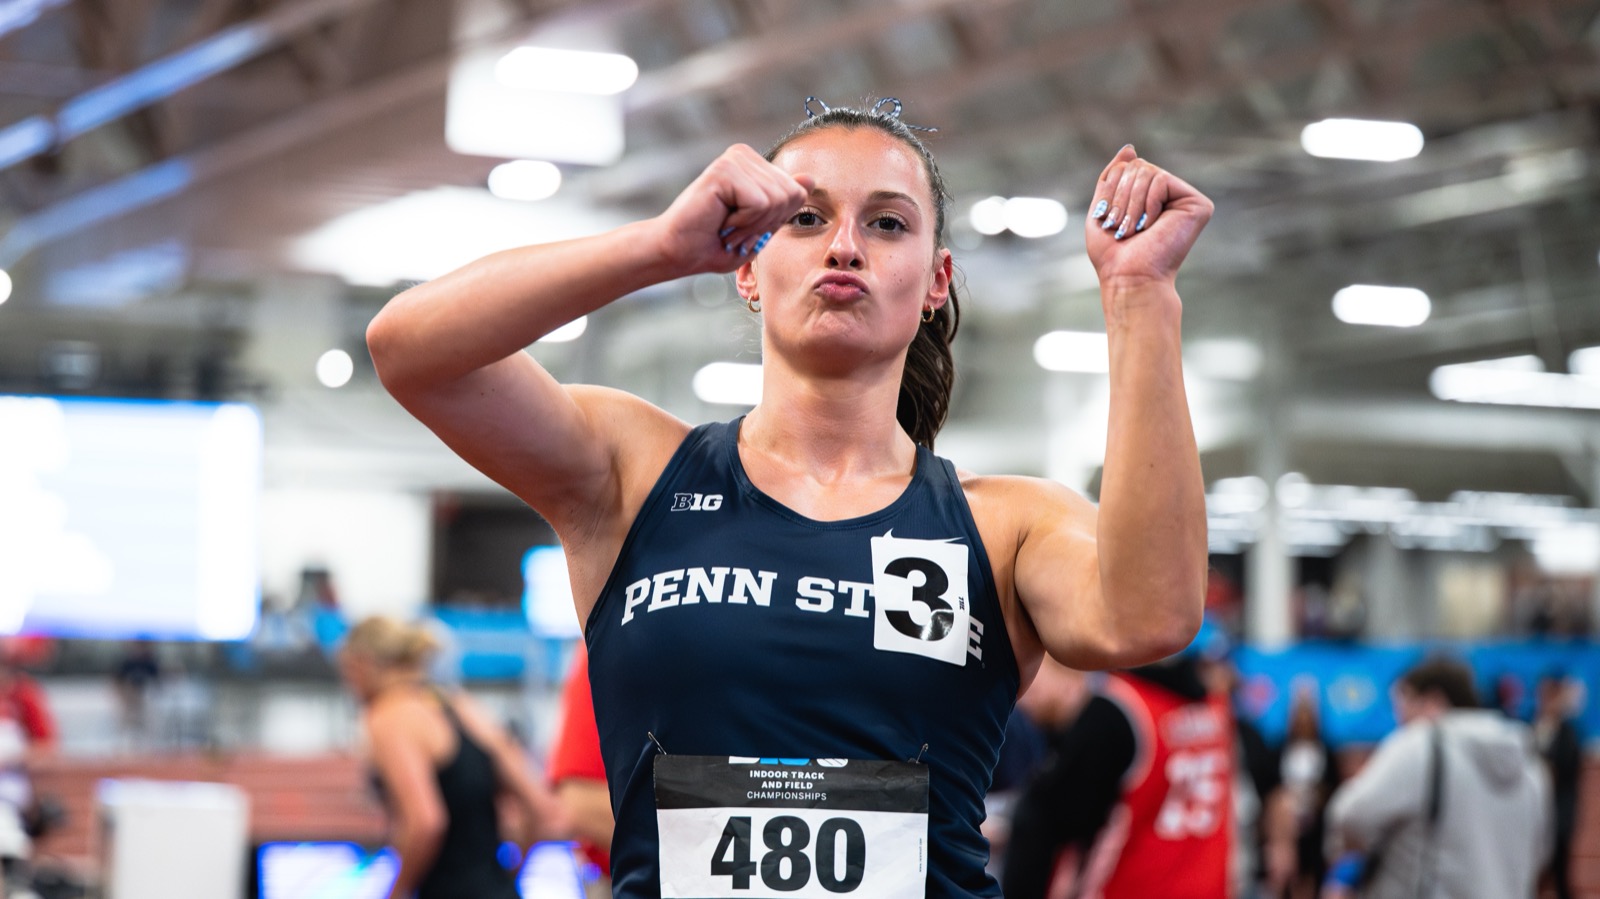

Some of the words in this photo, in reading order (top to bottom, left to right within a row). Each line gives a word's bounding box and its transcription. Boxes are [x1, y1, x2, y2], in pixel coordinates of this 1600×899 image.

[621, 567, 778, 626] PENN
[884, 557, 954, 641] 3
[749, 770, 788, 778] INDOOR
[791, 772, 825, 780] TRACK
[761, 781, 782, 789] AND
[746, 791, 827, 801] CHAMPIONSHIPS
[711, 815, 866, 893] 480
